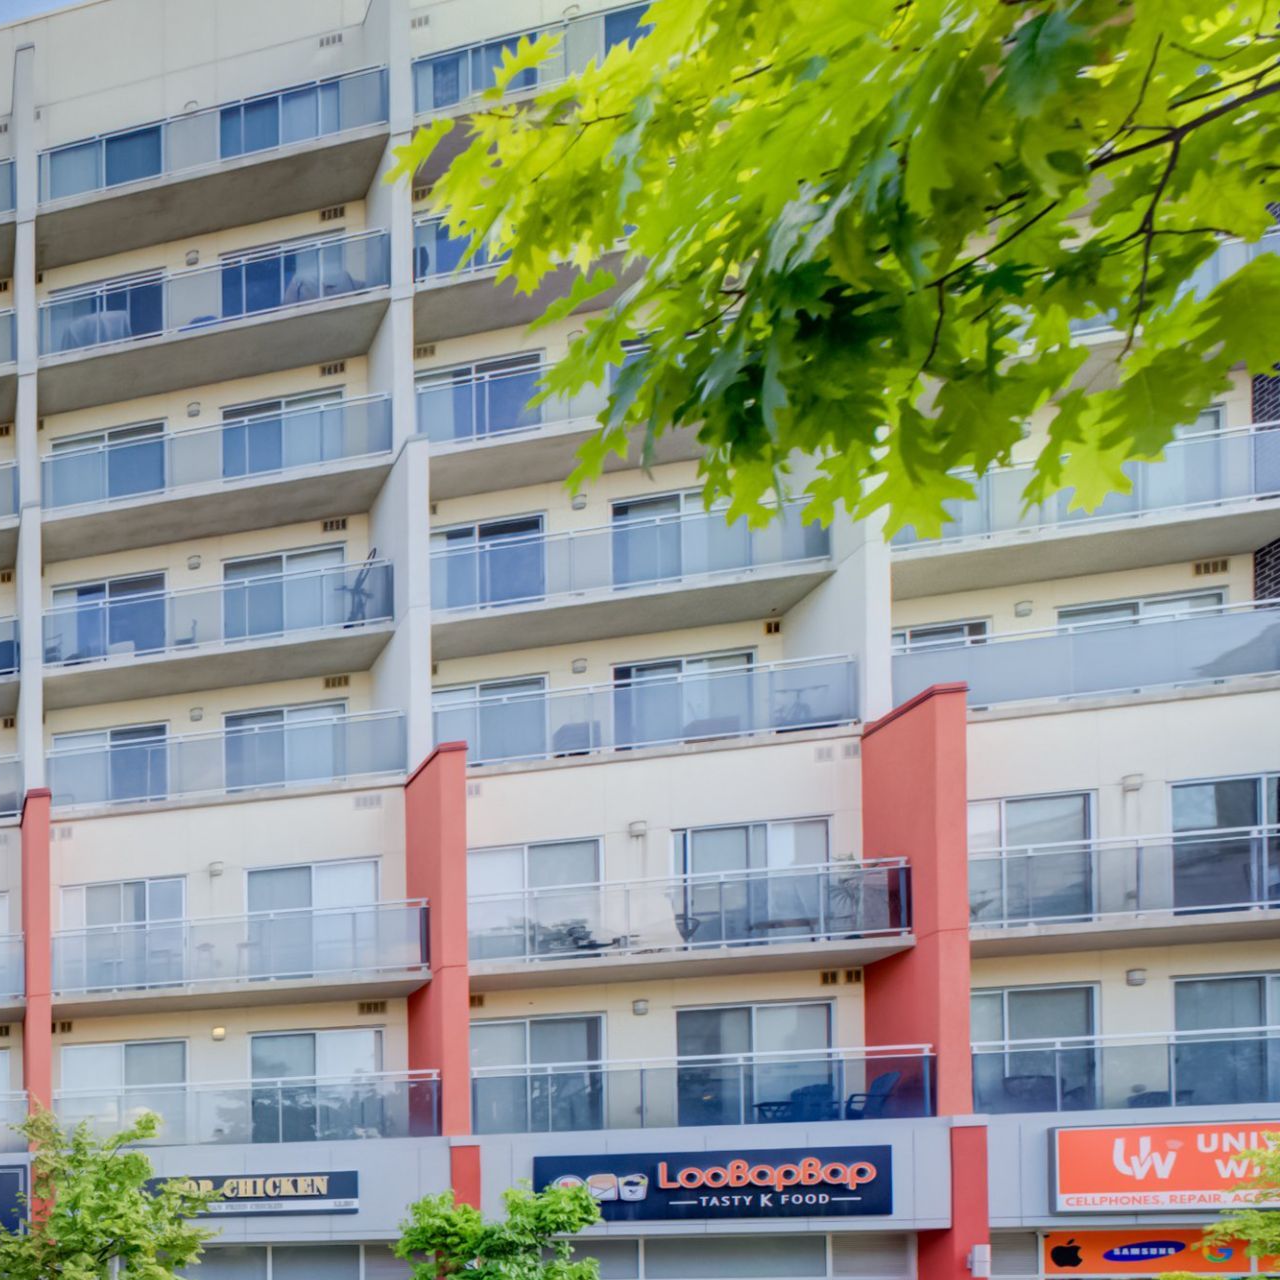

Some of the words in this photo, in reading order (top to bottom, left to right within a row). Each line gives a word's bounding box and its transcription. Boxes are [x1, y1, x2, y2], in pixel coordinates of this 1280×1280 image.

[223, 1175, 329, 1198] CHICKEN
[699, 1195, 753, 1207] TASTY
[760, 1193, 773, 1207] K
[781, 1193, 830, 1205] FOOD
[1113, 1247, 1176, 1256] SAMSUNG
